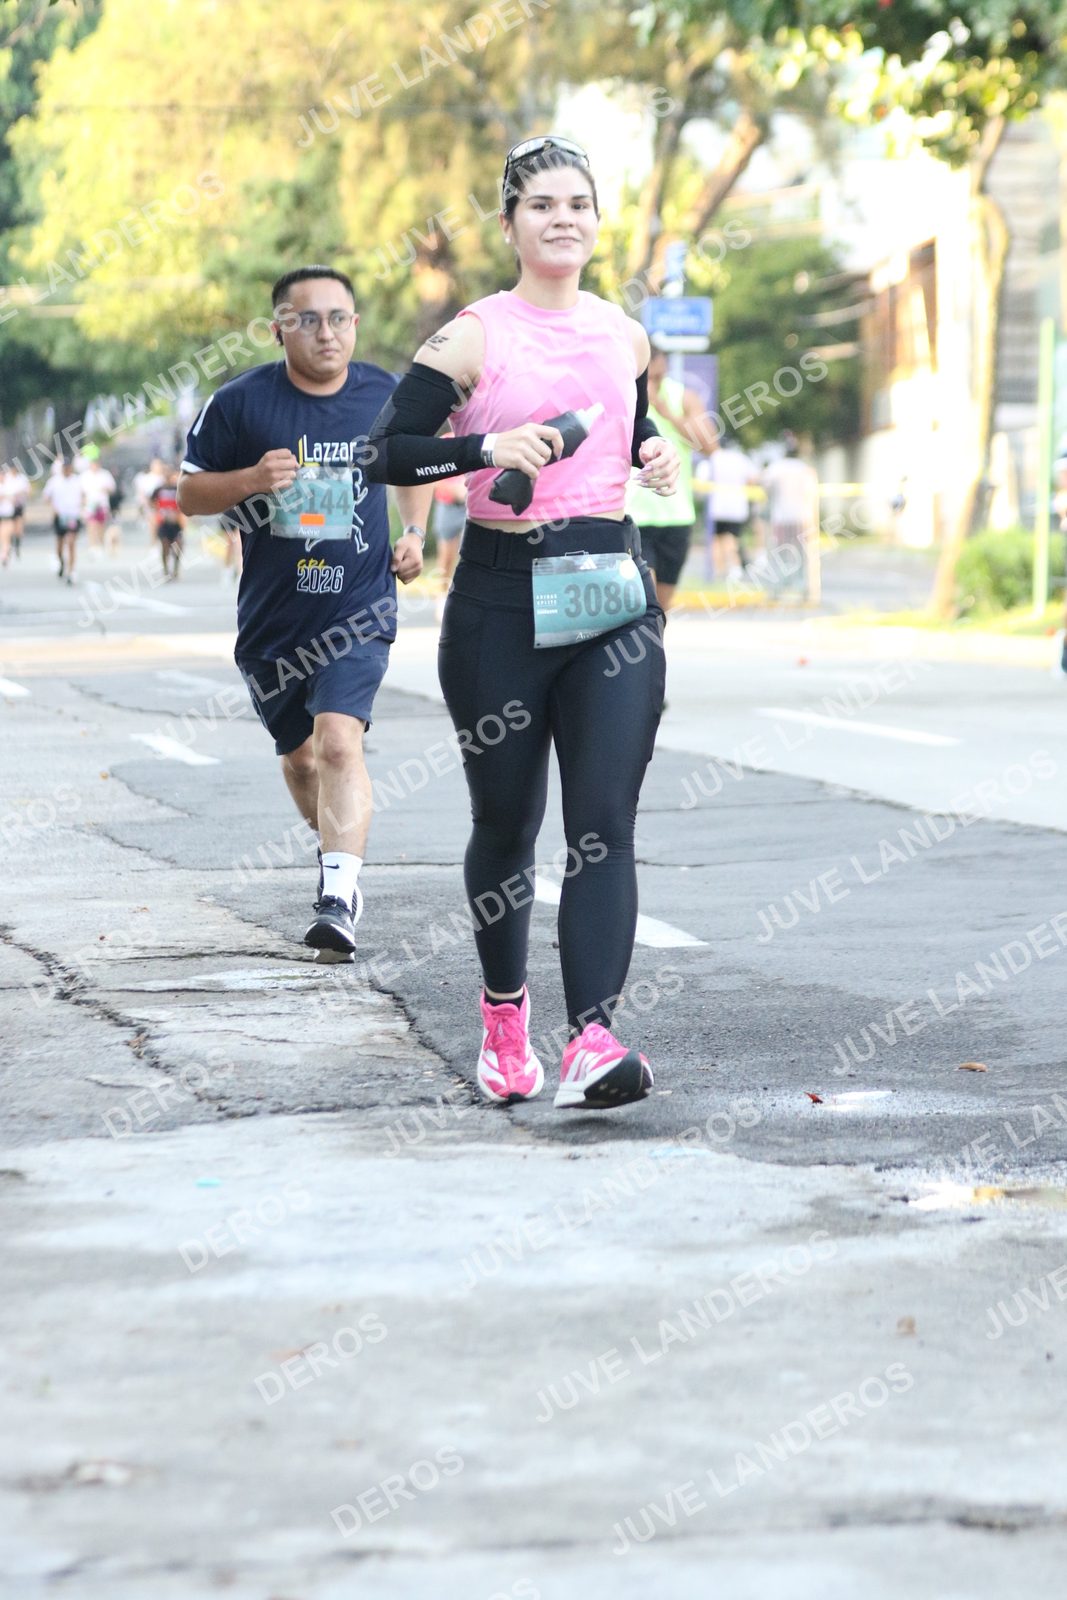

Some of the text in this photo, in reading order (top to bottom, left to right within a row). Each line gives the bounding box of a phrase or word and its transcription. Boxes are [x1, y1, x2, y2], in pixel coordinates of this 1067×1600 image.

[416, 462, 458, 477] KIPRUN
[297, 565, 344, 593] 2026
[564, 580, 641, 618] 3080
